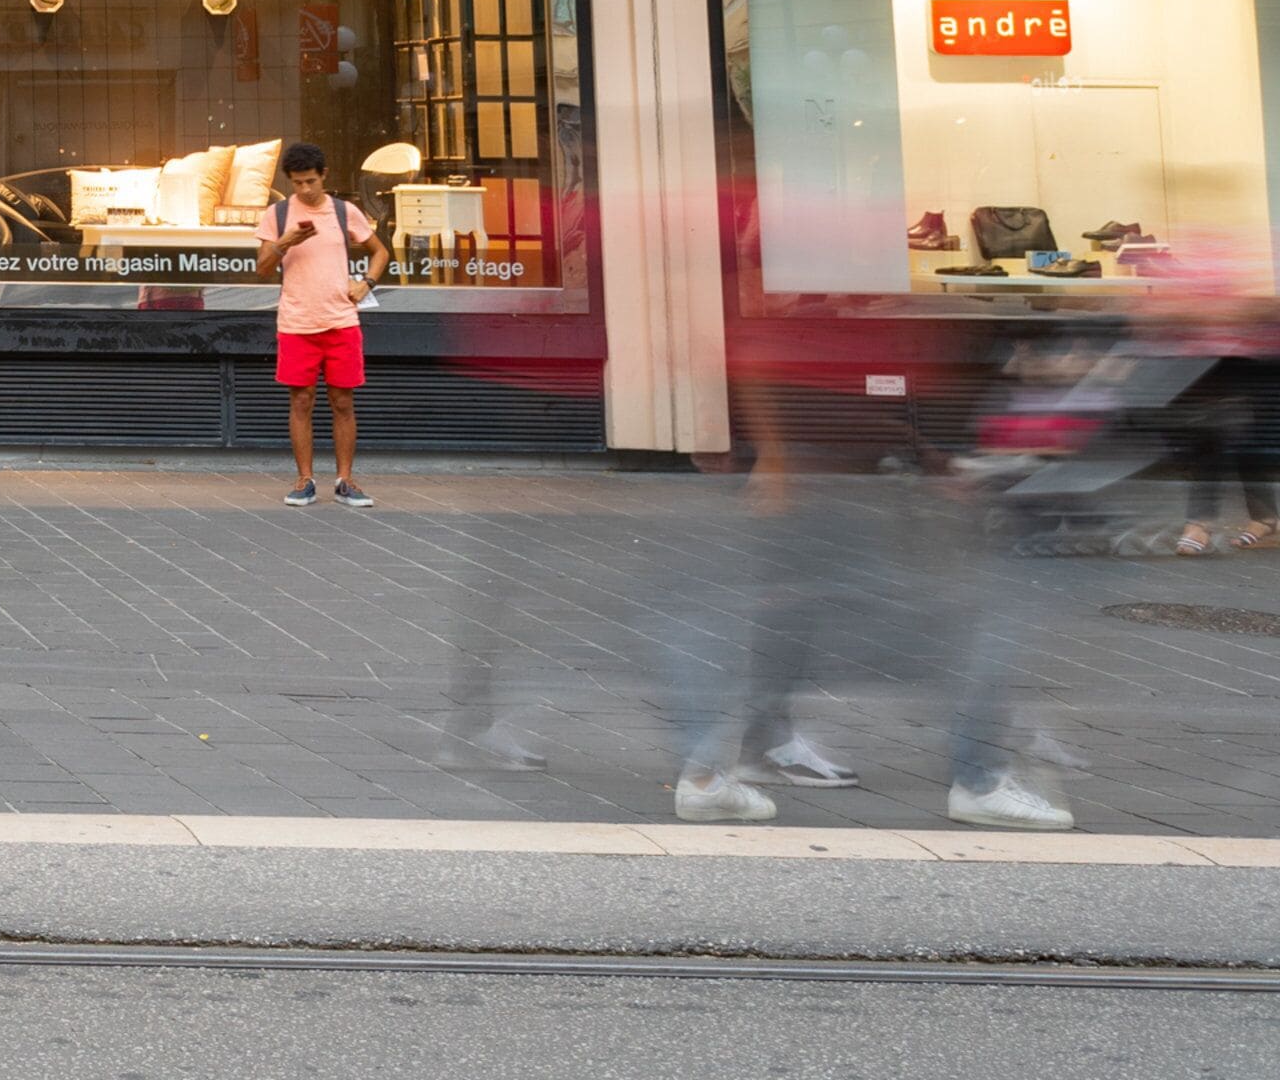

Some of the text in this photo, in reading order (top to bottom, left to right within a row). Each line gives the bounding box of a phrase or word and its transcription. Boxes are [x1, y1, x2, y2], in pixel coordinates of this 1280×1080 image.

[26, 254, 79, 272] votre
[85, 254, 173, 276] magasin
[178, 254, 257, 273] Maison
[389, 260, 415, 275] au
[465, 257, 525, 281] étage
